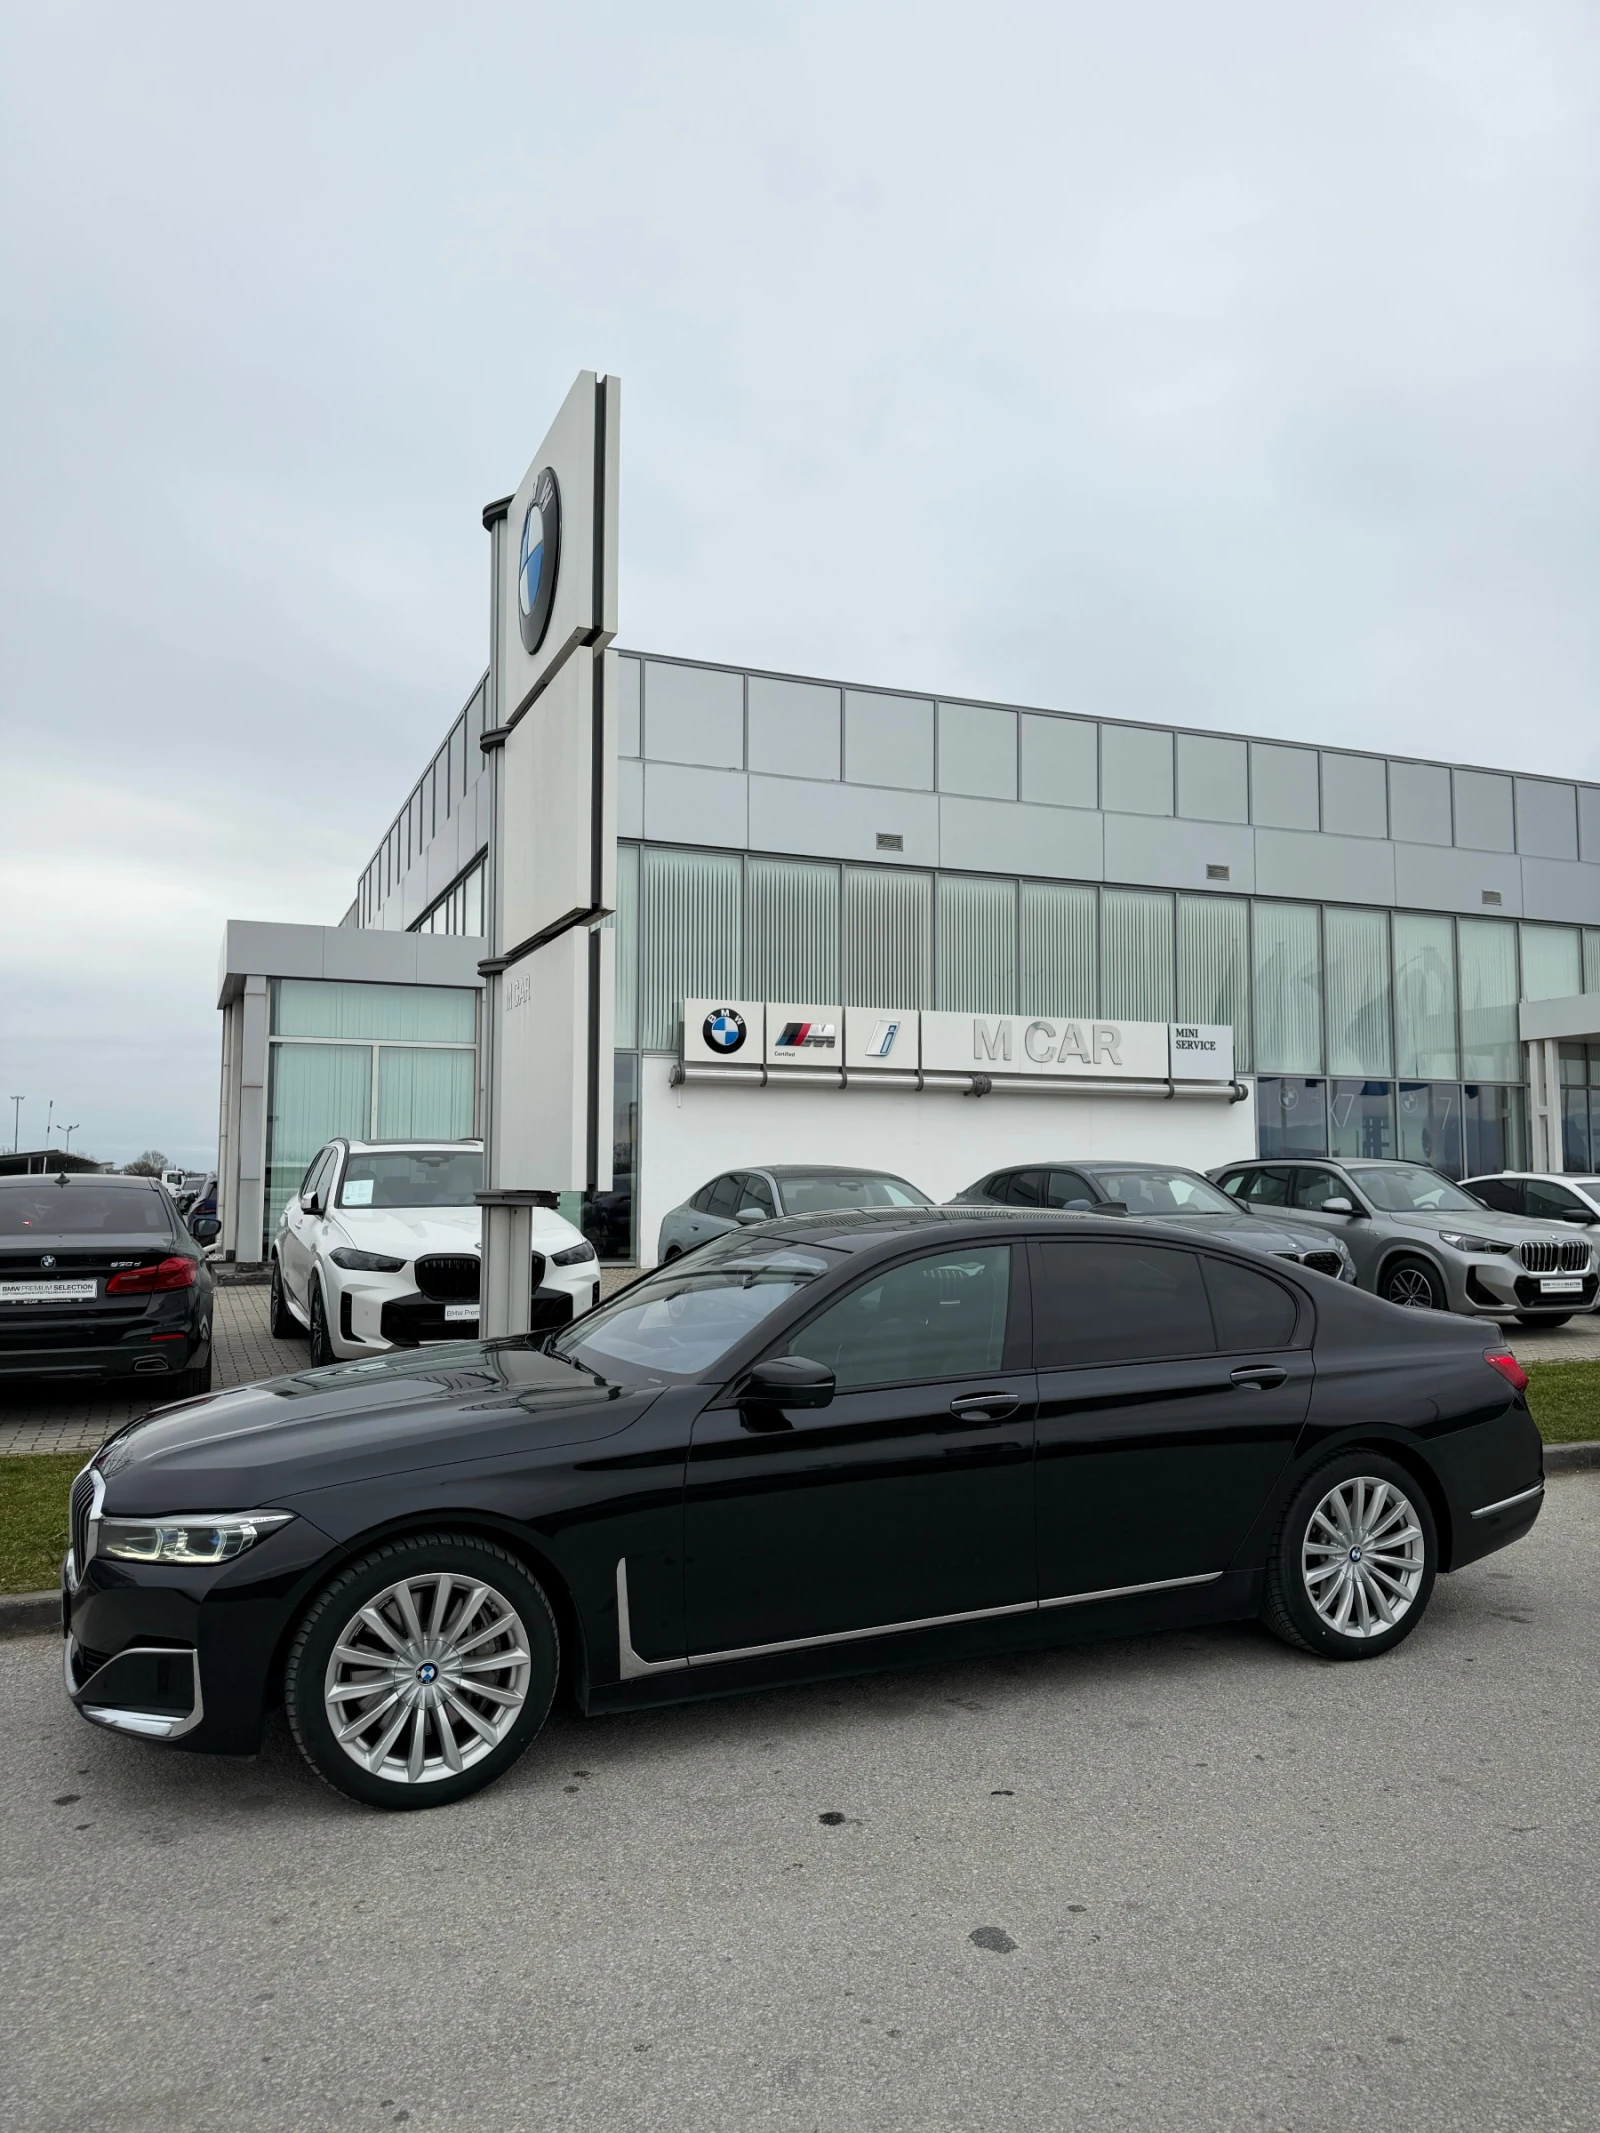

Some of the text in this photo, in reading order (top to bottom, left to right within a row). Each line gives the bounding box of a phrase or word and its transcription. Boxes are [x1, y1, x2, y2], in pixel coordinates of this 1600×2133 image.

[707, 1009, 744, 1025] BMW
[1175, 1028, 1198, 1038] MINI
[973, 1018, 1123, 1066] M CAR
[1175, 1040, 1216, 1051] SERVICE
